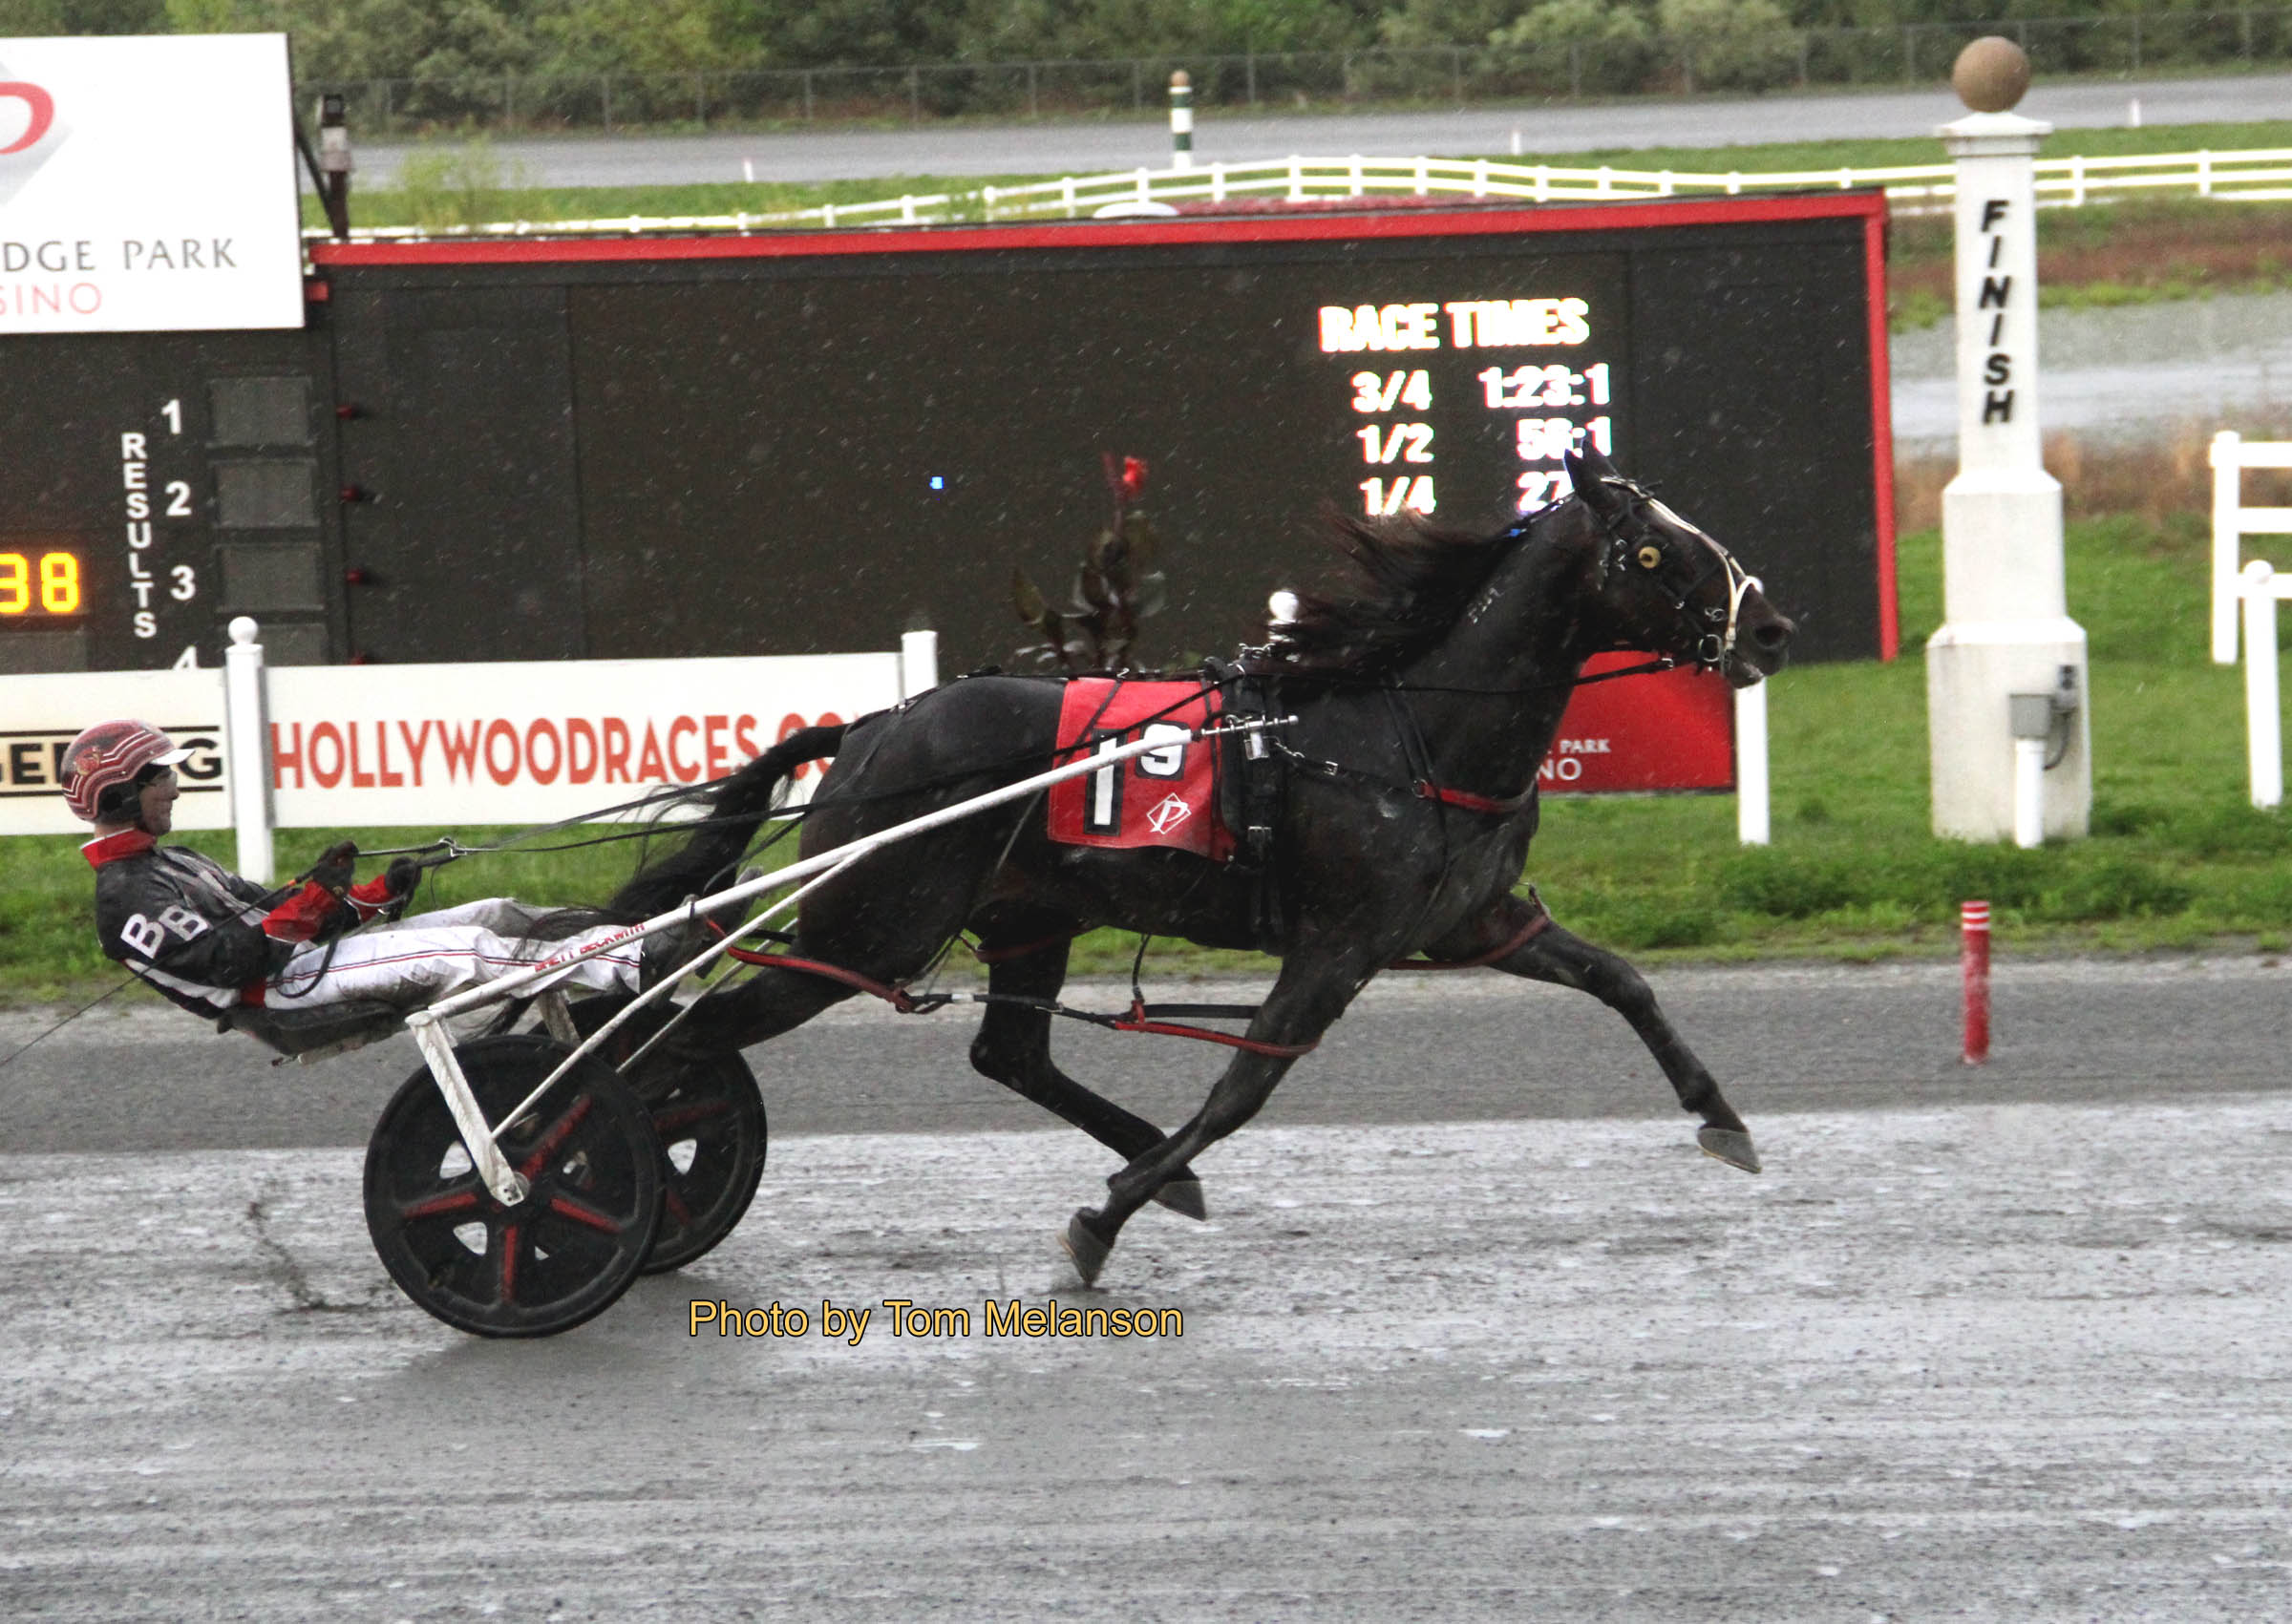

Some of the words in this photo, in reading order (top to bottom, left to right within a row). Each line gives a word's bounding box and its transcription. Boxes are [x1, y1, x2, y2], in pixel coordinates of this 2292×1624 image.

[122, 238, 238, 270] PARK
[1319, 302, 1440, 352] RACE
[1443, 297, 1590, 348] TIMES
[1979, 199, 2014, 425] FINISH
[1350, 369, 1432, 412] 3/4
[160, 399, 181, 435] 1
[1355, 423, 1434, 464] 1/2
[164, 480, 192, 517] 2
[1359, 475, 1437, 516] 1/4
[121, 432, 158, 639] RESULTS
[170, 565, 197, 601] 3
[1559, 738, 1611, 754] PARK
